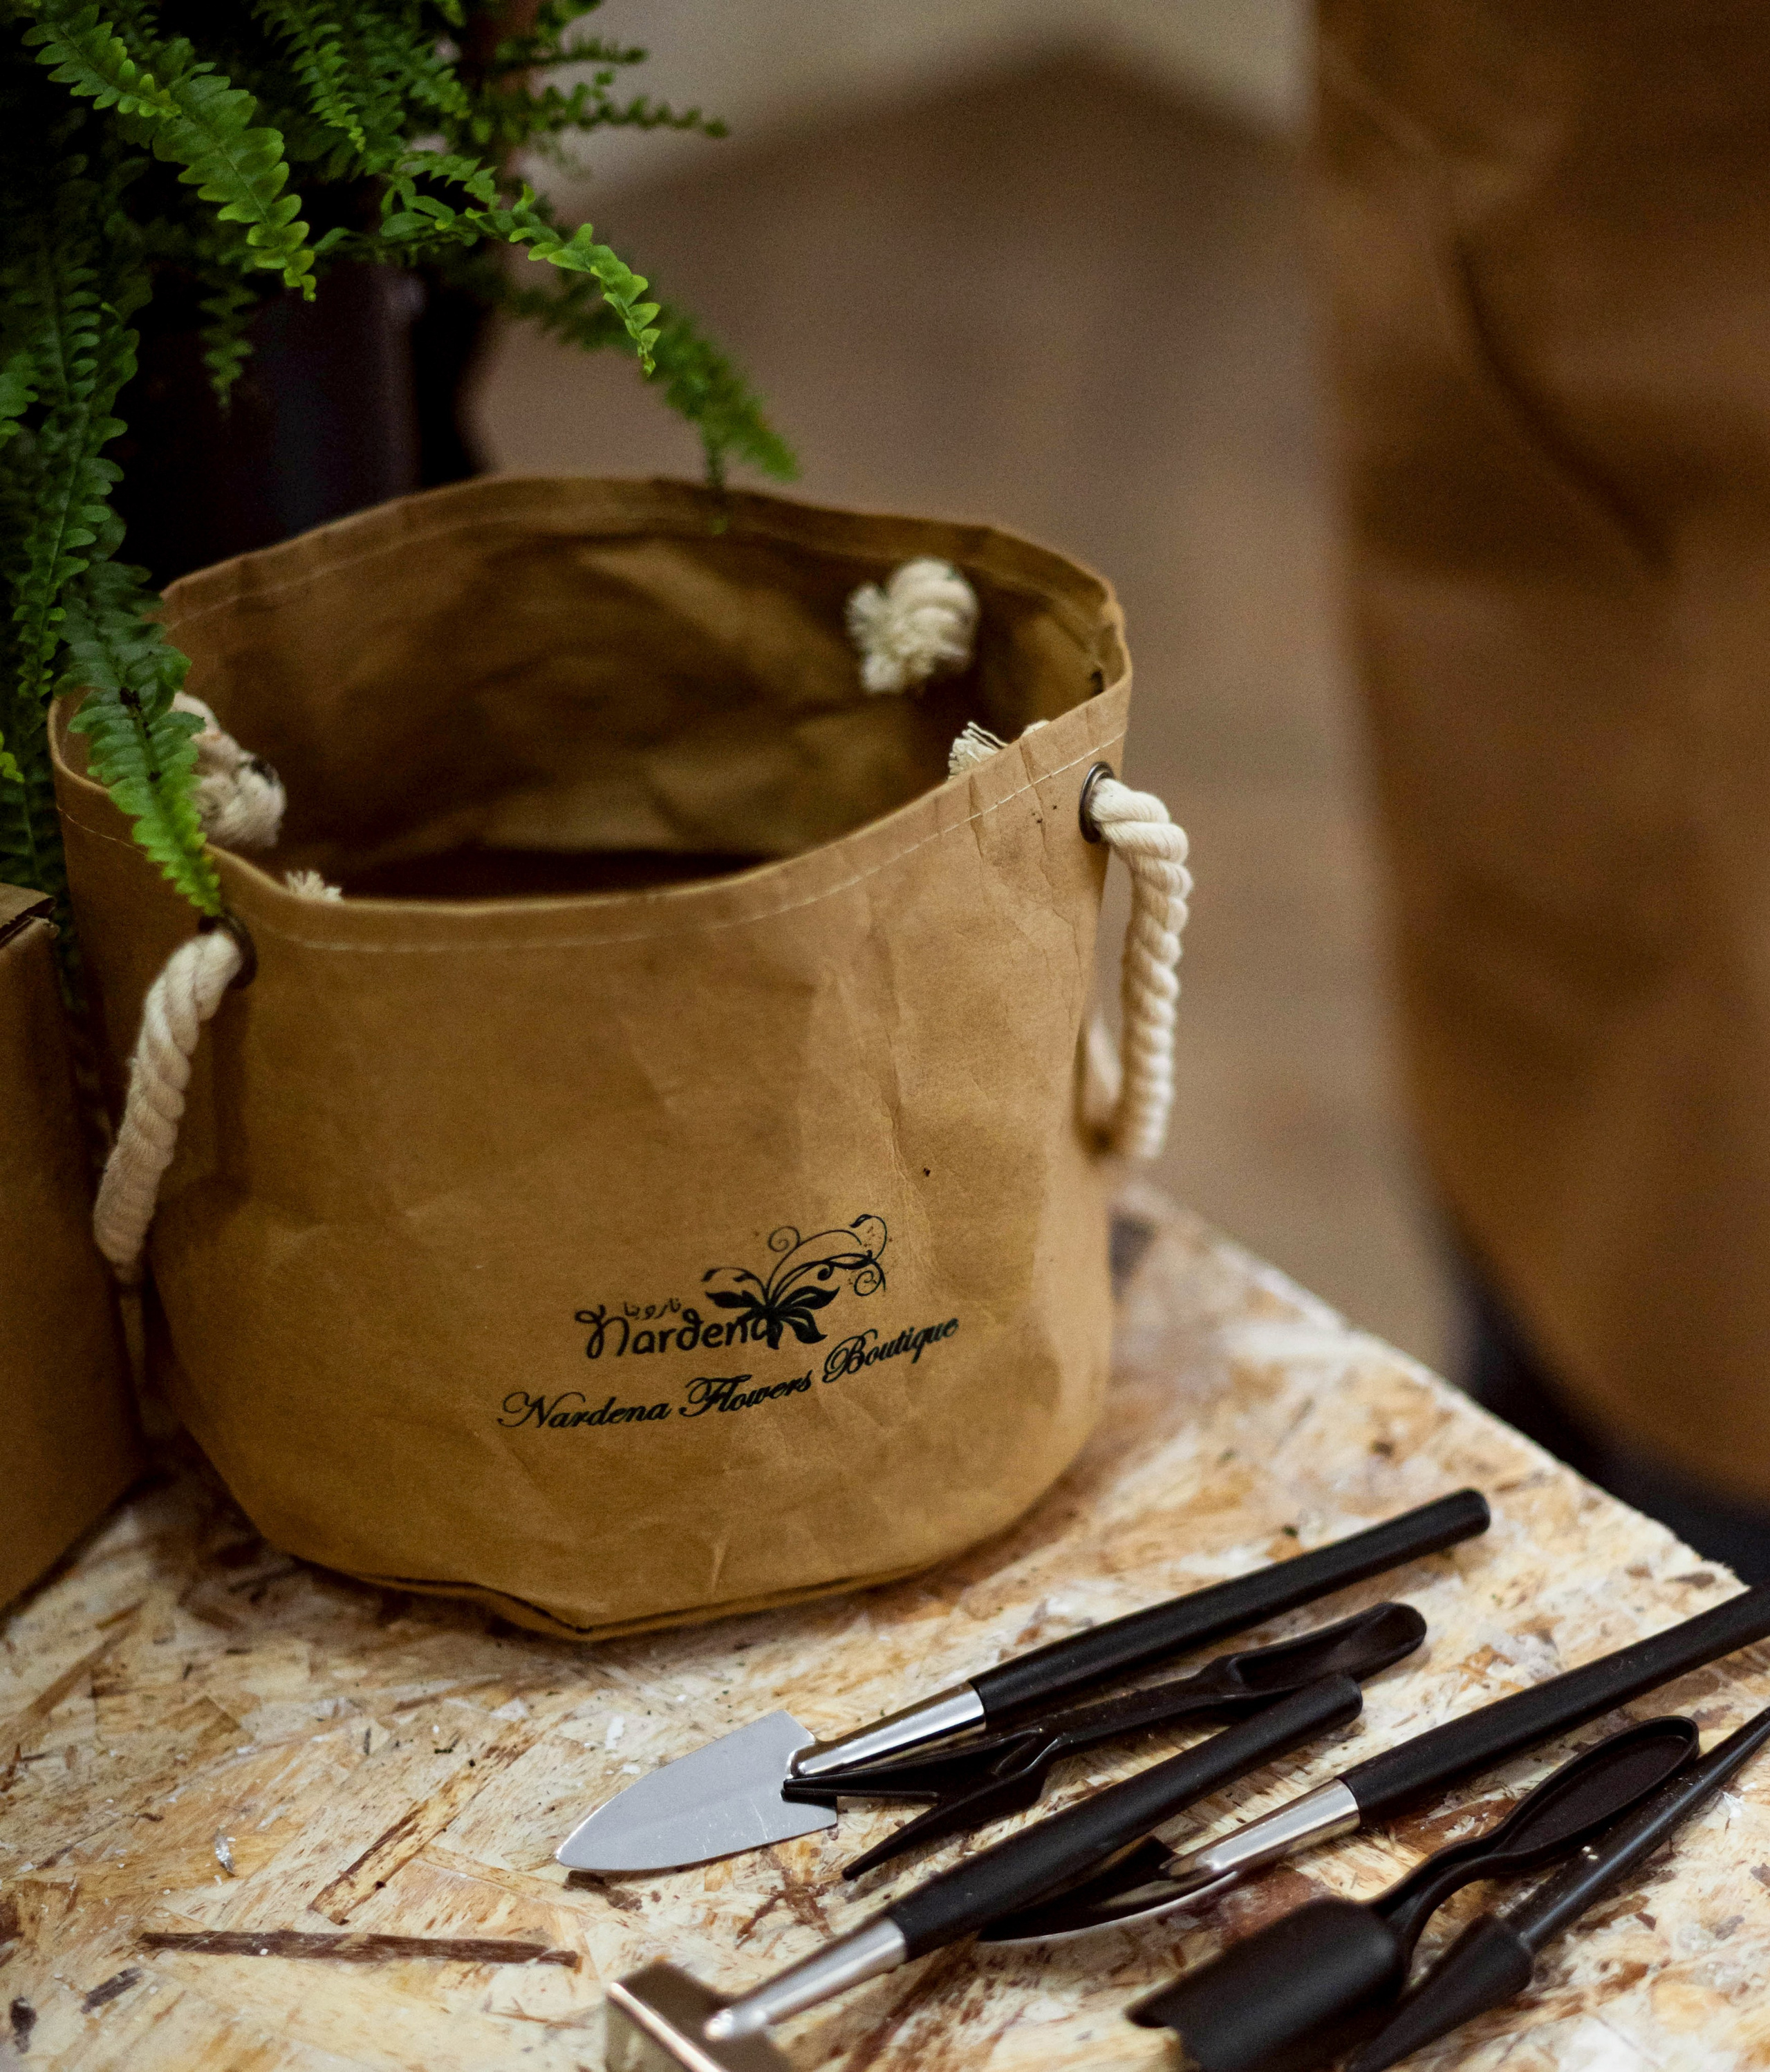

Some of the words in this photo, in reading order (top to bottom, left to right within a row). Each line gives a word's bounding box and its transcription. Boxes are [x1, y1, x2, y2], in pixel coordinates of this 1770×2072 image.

[497, 1391, 672, 1428] Nardena
[678, 1369, 813, 1418] Flowers
[822, 1317, 959, 1383] Boutique
